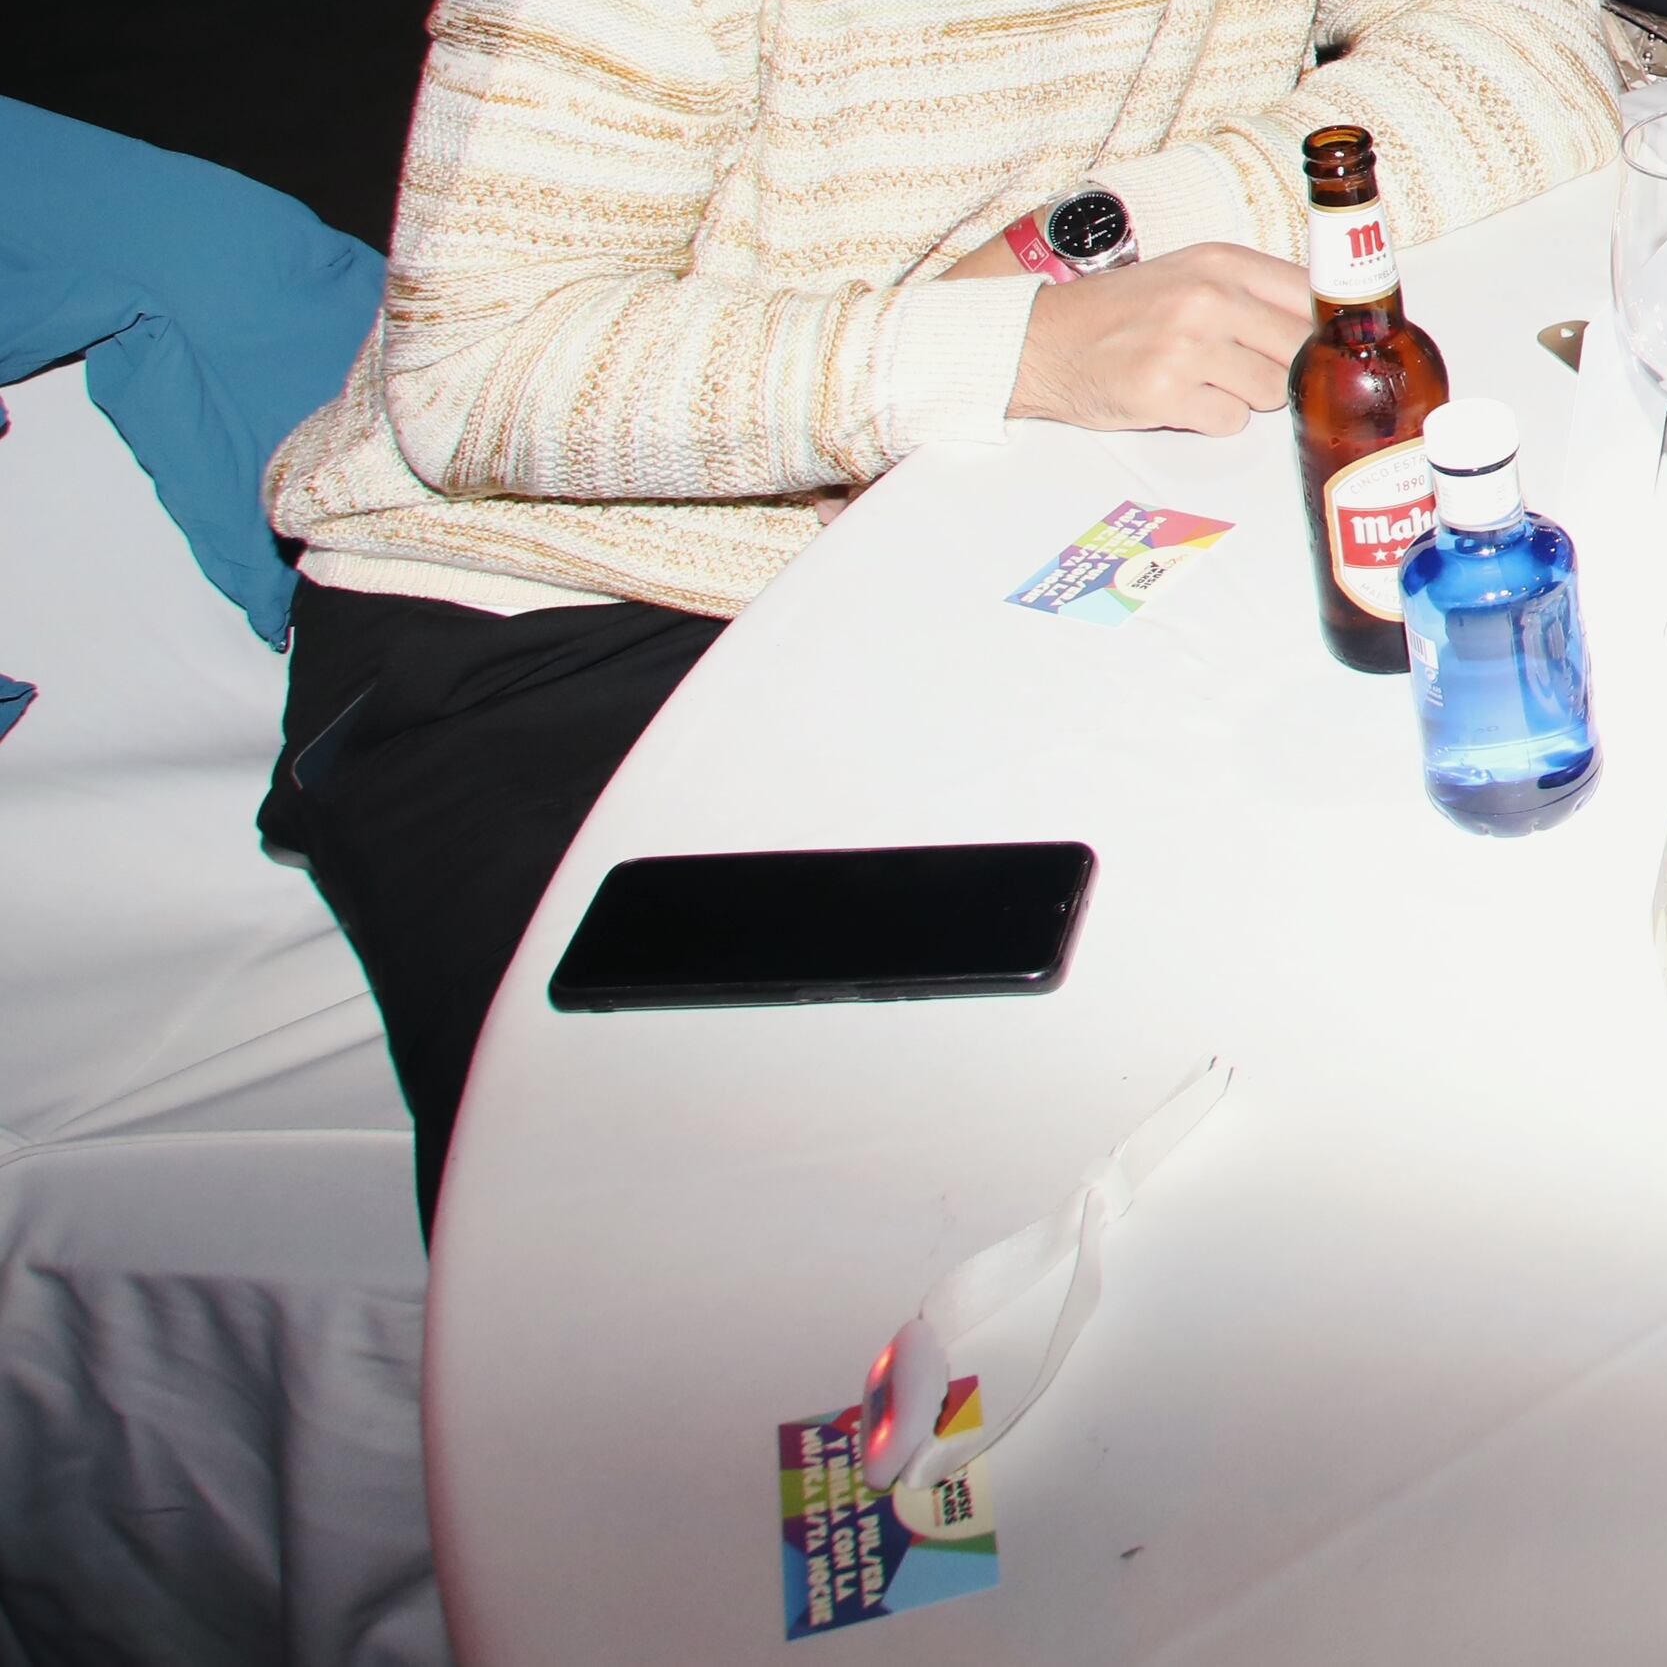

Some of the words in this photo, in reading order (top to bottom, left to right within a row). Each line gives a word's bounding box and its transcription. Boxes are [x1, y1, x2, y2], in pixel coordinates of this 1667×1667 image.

[1345, 220, 1385, 259] m
[1395, 474, 1425, 494] 1890
[1350, 506, 1437, 545] Mah
